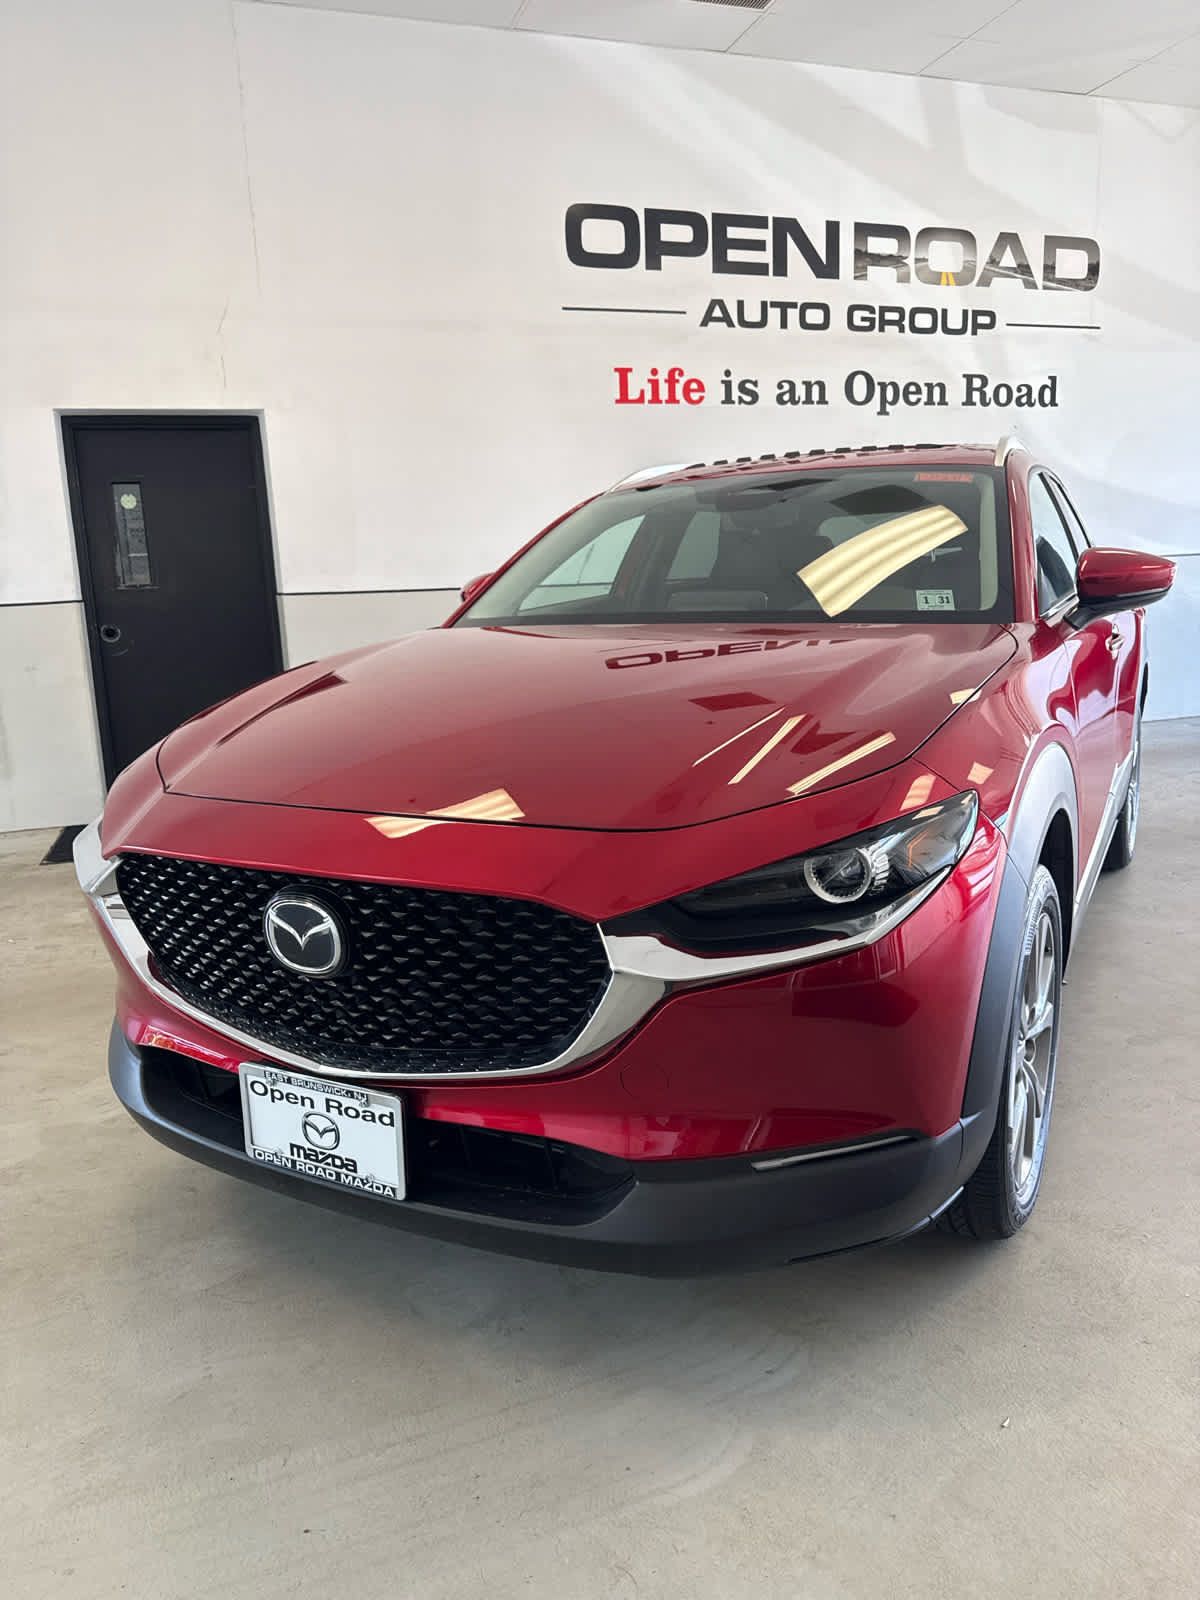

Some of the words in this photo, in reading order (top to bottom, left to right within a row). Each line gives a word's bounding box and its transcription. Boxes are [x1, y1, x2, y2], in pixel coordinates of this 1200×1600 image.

[565, 202, 840, 280] OPEN
[853, 222, 1101, 292] ROAD
[700, 298, 831, 331] AUTO
[847, 304, 997, 336] GROUP
[613, 367, 706, 406] Life
[721, 369, 760, 406] is
[775, 374, 829, 406] an
[844, 370, 949, 416] Open
[961, 373, 1059, 409] Road
[265, 1071, 289, 1083] EAST
[250, 1080, 315, 1109] Open
[325, 1099, 395, 1127] Road
[254, 1150, 292, 1168] OPEN
[296, 1161, 337, 1180] ROAD
[340, 1173, 395, 1198] MAZDA
